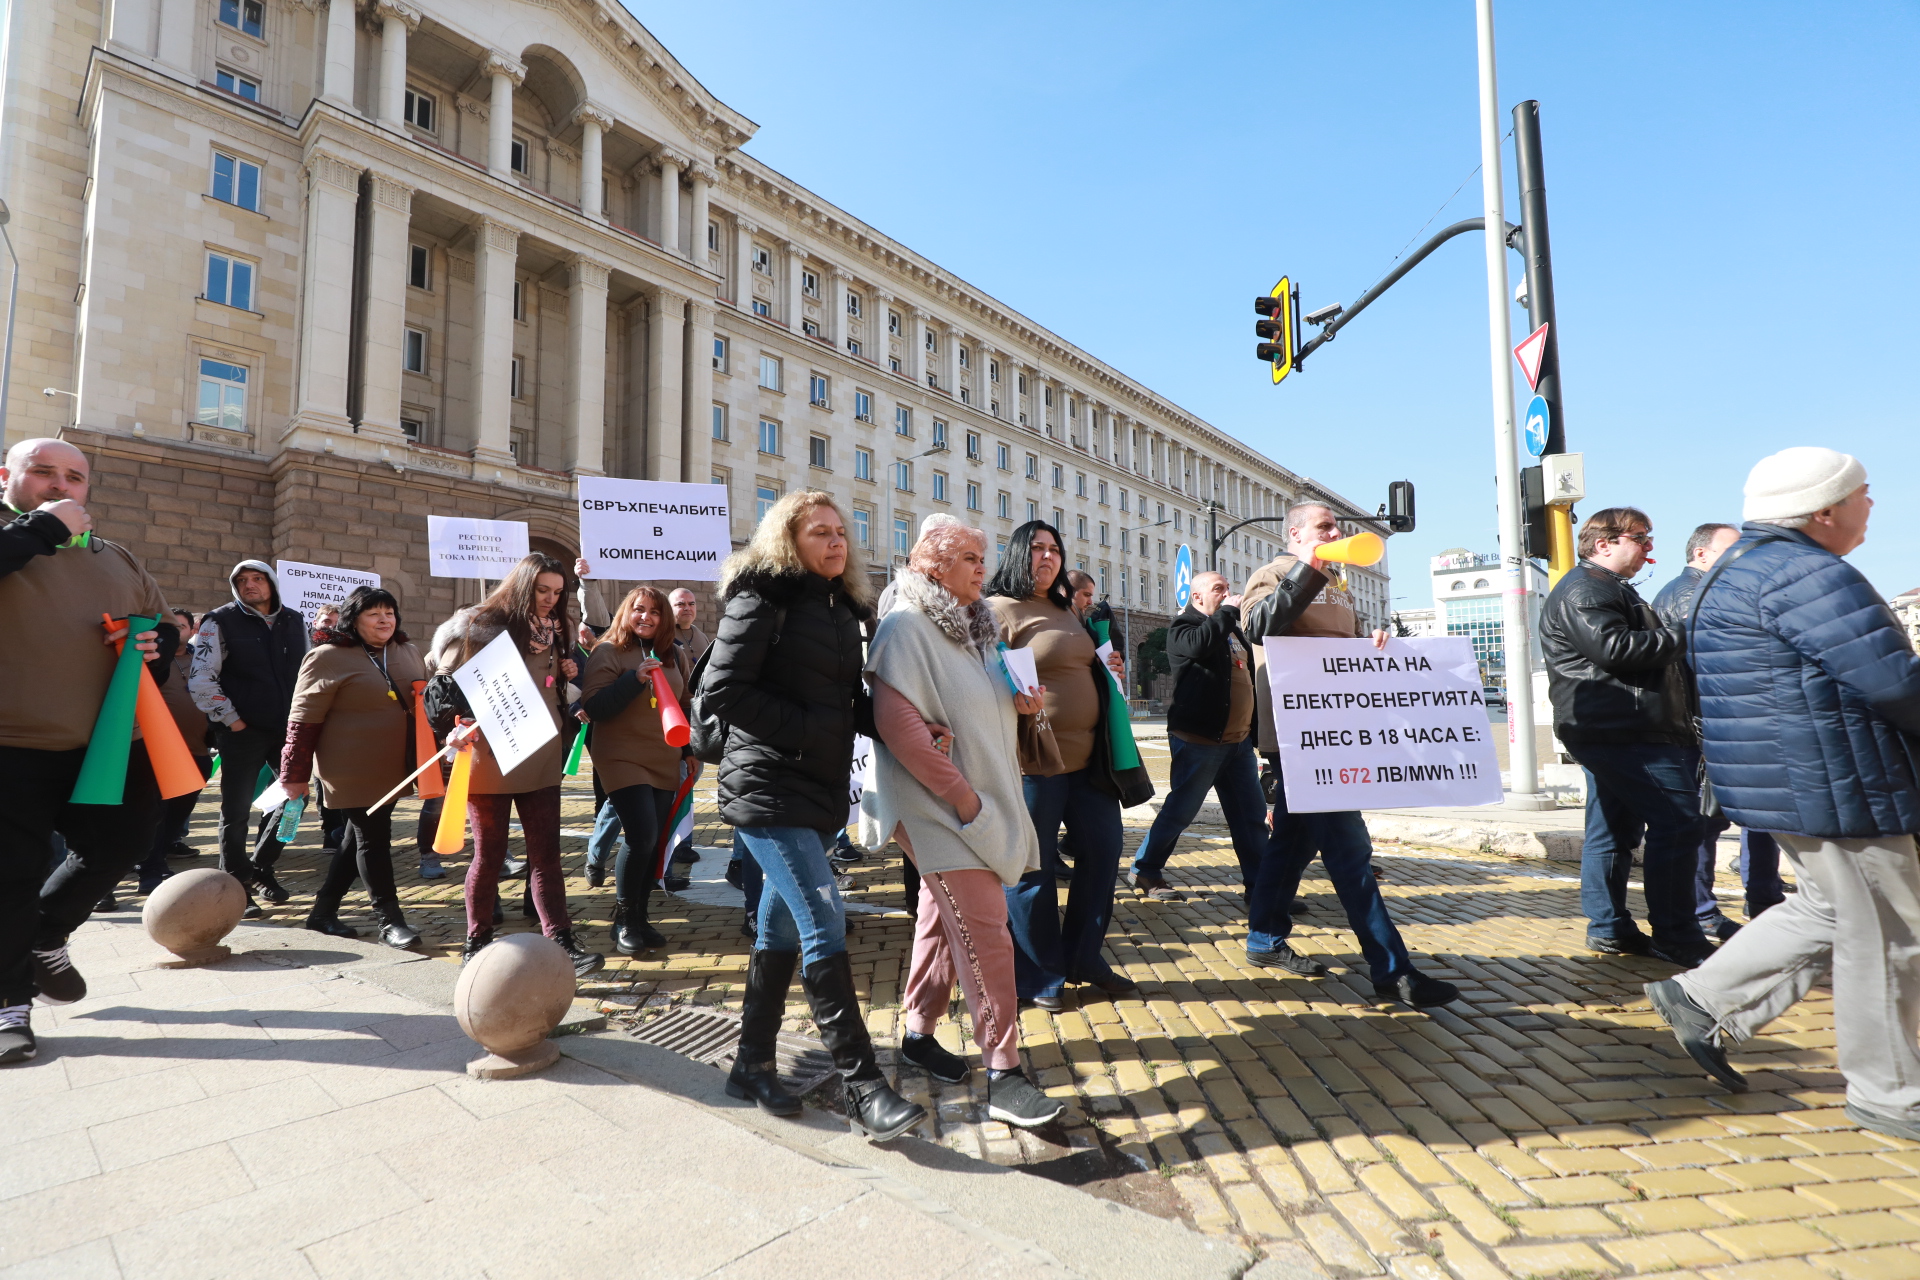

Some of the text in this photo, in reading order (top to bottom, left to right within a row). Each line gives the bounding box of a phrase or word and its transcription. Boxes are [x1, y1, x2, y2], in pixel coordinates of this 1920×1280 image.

[582, 499, 727, 517] СВРЪХПЕЧАЛБИТЕ
[458, 533, 502, 543] РЕСТОТО
[653, 526, 663, 537] В
[439, 553, 466, 561] ТОКА
[458, 544, 504, 553] ВЪРНЕТЕ,
[599, 547, 717, 563] КОМПЕНСАЦИИ
[286, 568, 375, 587] СВРЪХПЕЧАЛБИТЕ
[303, 590, 346, 602] НЯМА ДА
[320, 582, 347, 593] СЕГА,
[1322, 656, 1433, 676] ЦЕНАТА НА
[501, 671, 529, 719] РЕСТОТО
[1282, 690, 1484, 710] ЕЛЕКТРОЕНЕРГИЯТА
[472, 666, 520, 754] ТОКА НАМАЛЕТЕ!
[1300, 726, 1482, 750] ДНЕС В 18 ЧАСА Е:
[1315, 763, 1478, 785] !!! 672 ЛВ/MWh !!!
